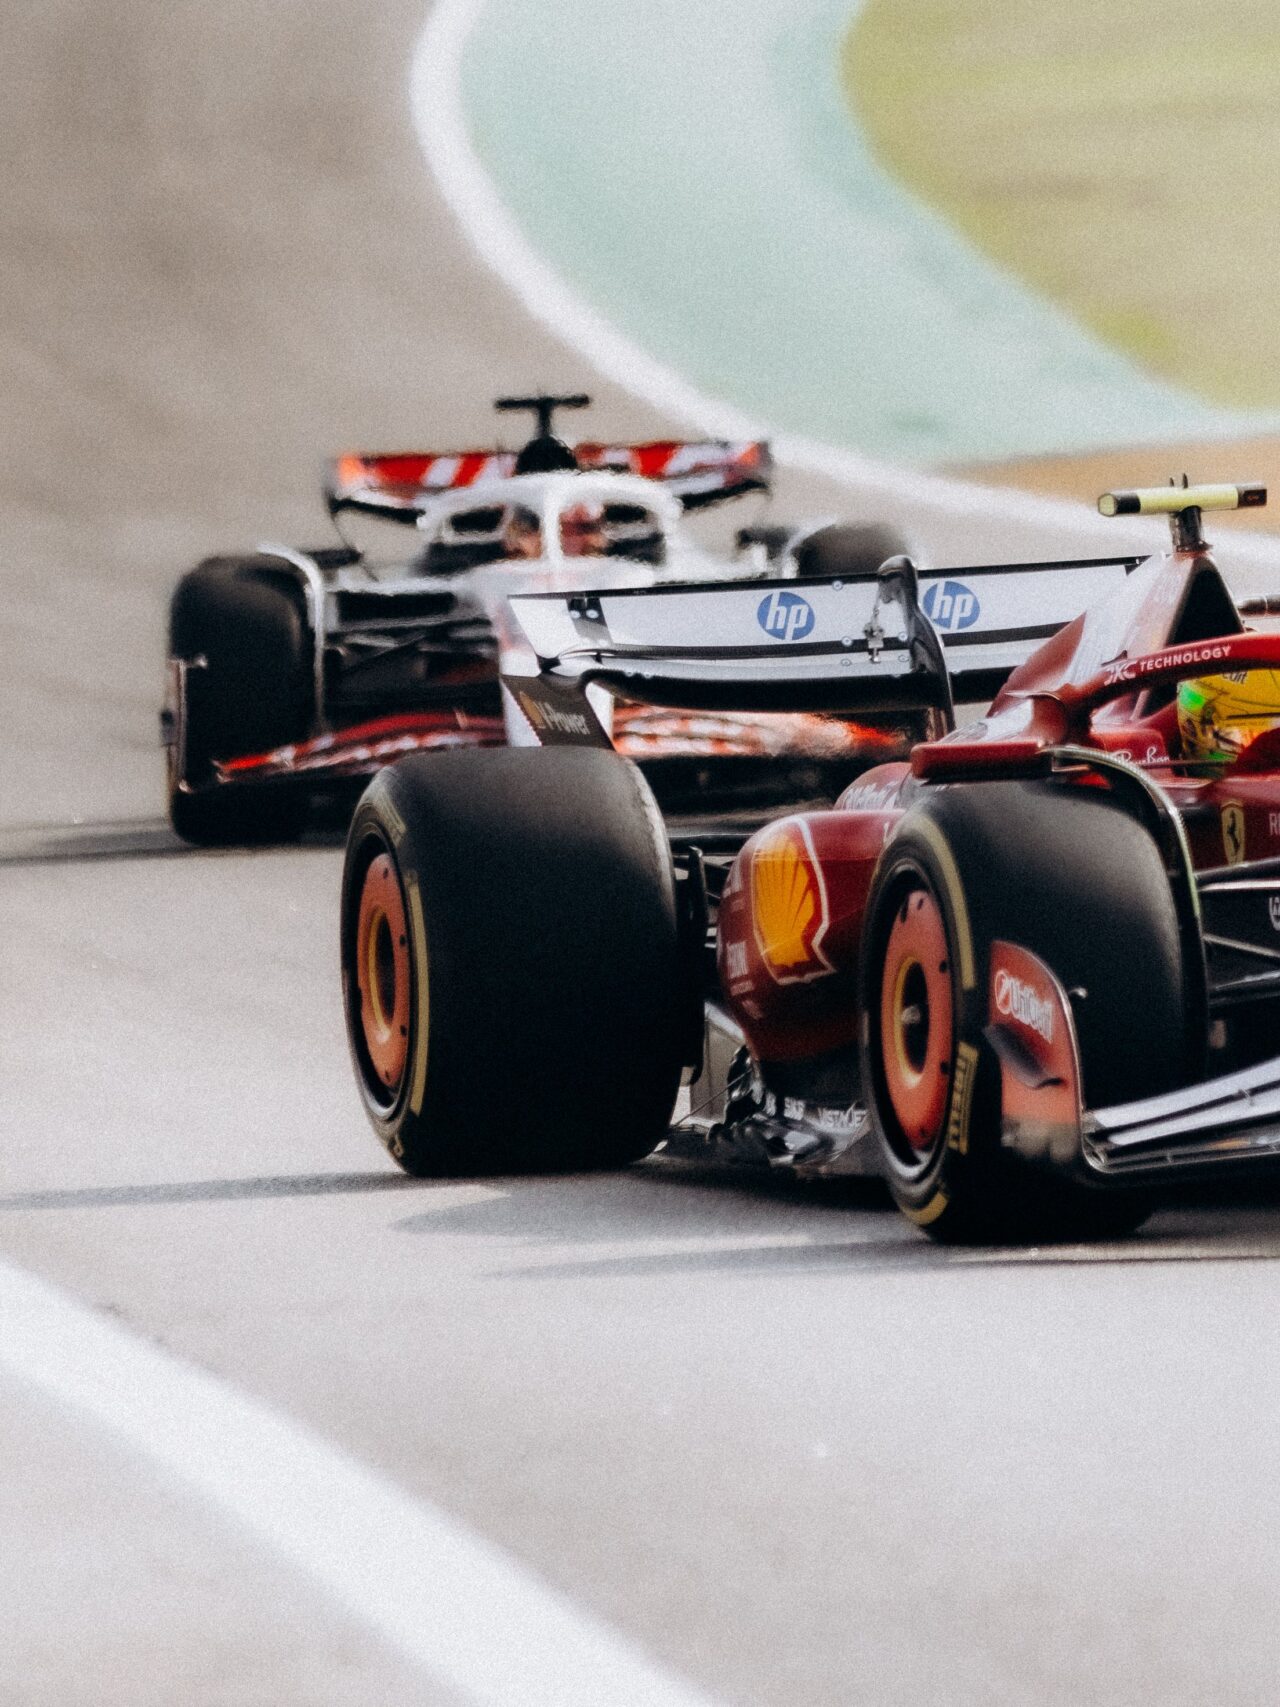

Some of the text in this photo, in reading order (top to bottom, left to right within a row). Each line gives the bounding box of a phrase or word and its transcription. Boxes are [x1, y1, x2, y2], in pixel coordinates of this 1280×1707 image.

[762, 592, 814, 640] hp
[928, 581, 976, 630] hp
[1140, 646, 1232, 672] TECHNOLOGY
[533, 701, 591, 735] V-Power
